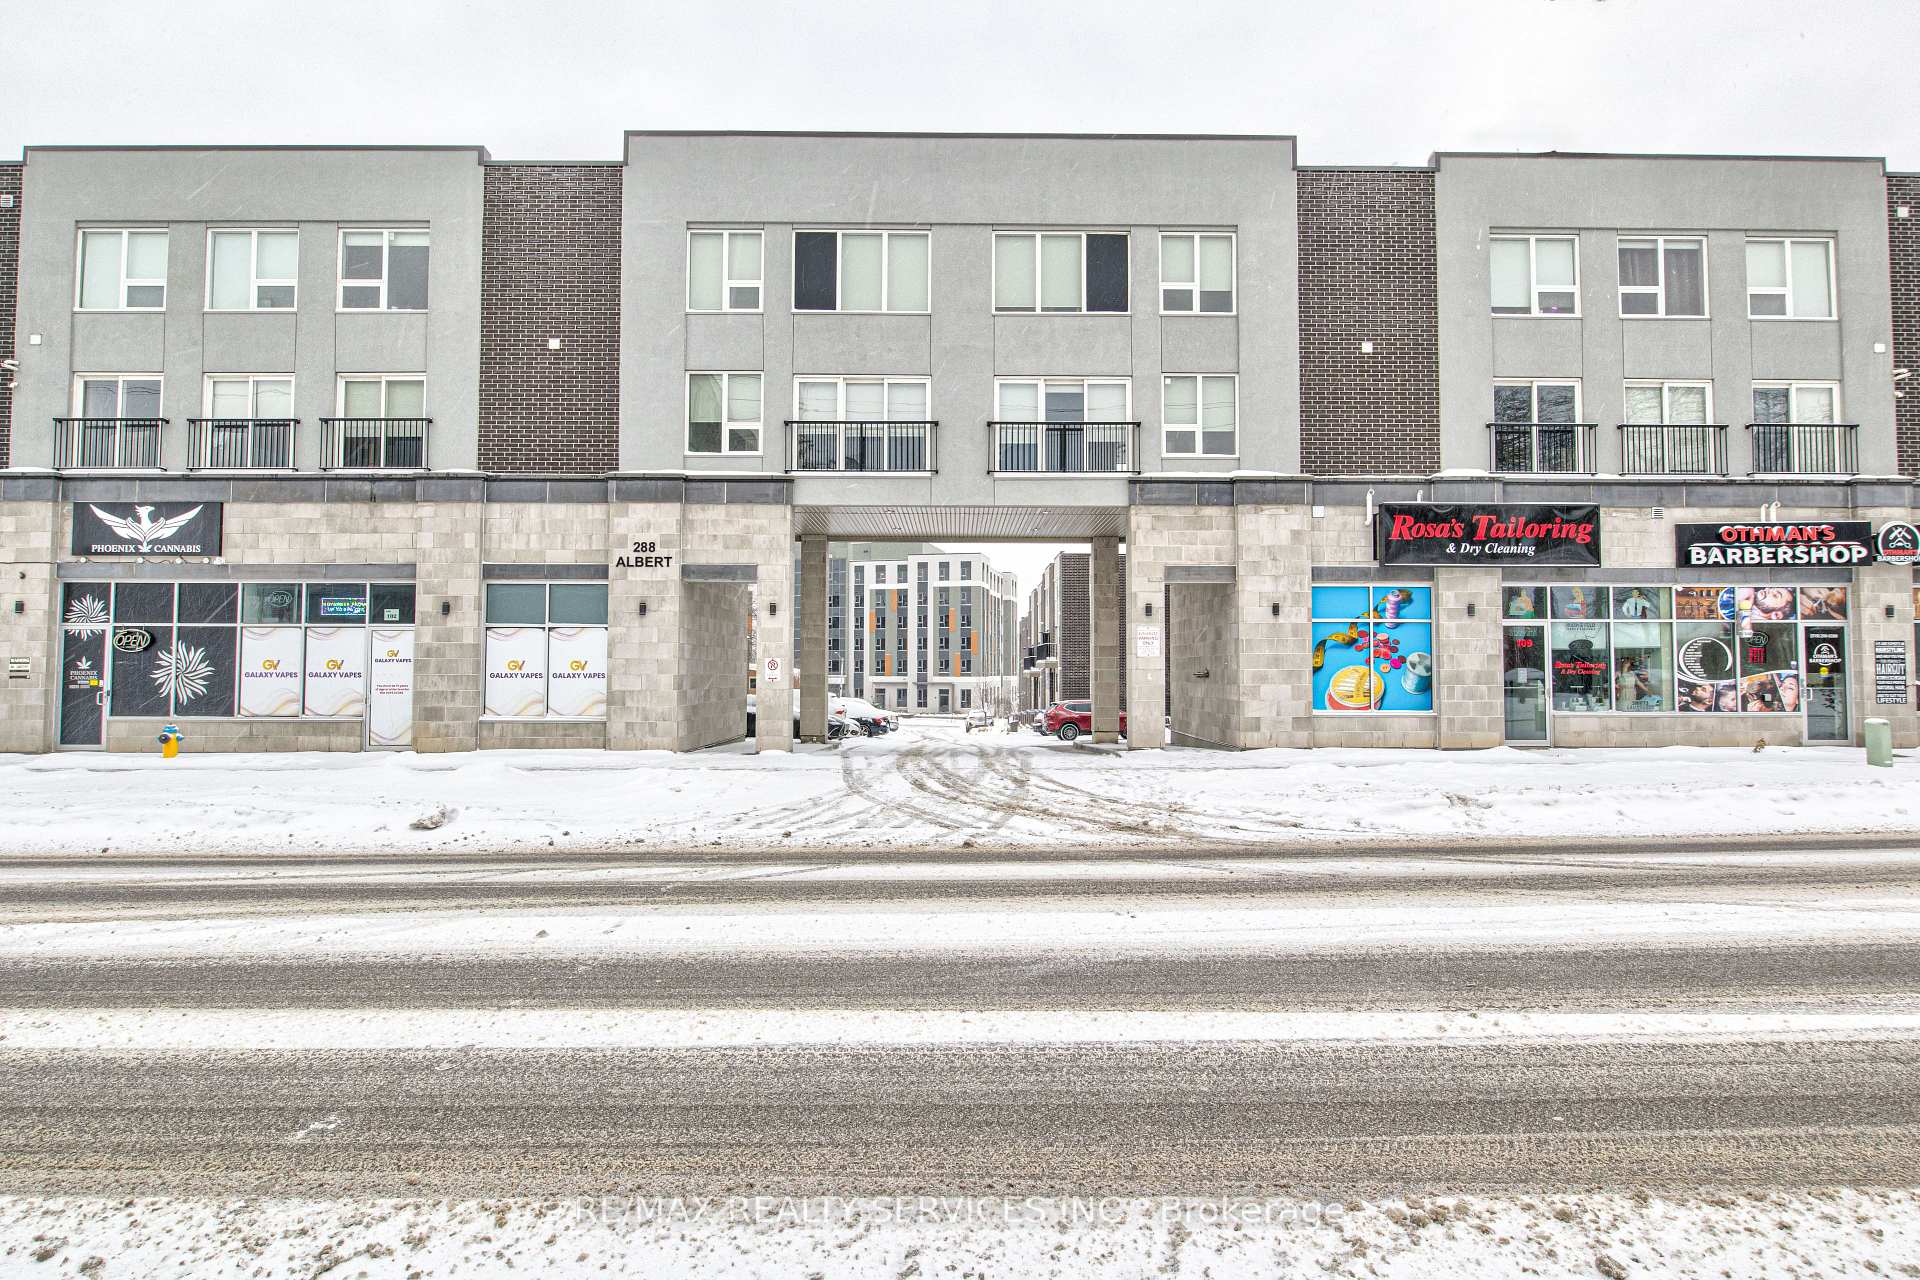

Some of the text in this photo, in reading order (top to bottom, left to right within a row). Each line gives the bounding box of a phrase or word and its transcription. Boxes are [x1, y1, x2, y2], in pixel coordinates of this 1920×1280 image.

[1389, 515, 1594, 544] Rosa's Tailoring
[1721, 526, 1836, 542] OTHMAN'S
[91, 544, 201, 553] PHOENIX CANNABIS
[633, 541, 656, 553] 288
[1446, 543, 1536, 556] & Dry Cleaning
[1690, 545, 1868, 565] BARBERSHOP
[615, 556, 672, 568] ALBERT
[116, 634, 147, 647] OPEN
[387, 649, 399, 657] GV
[262, 659, 280, 670] GV
[325, 659, 344, 670] GV
[507, 659, 526, 671] GV
[569, 659, 588, 671] GV
